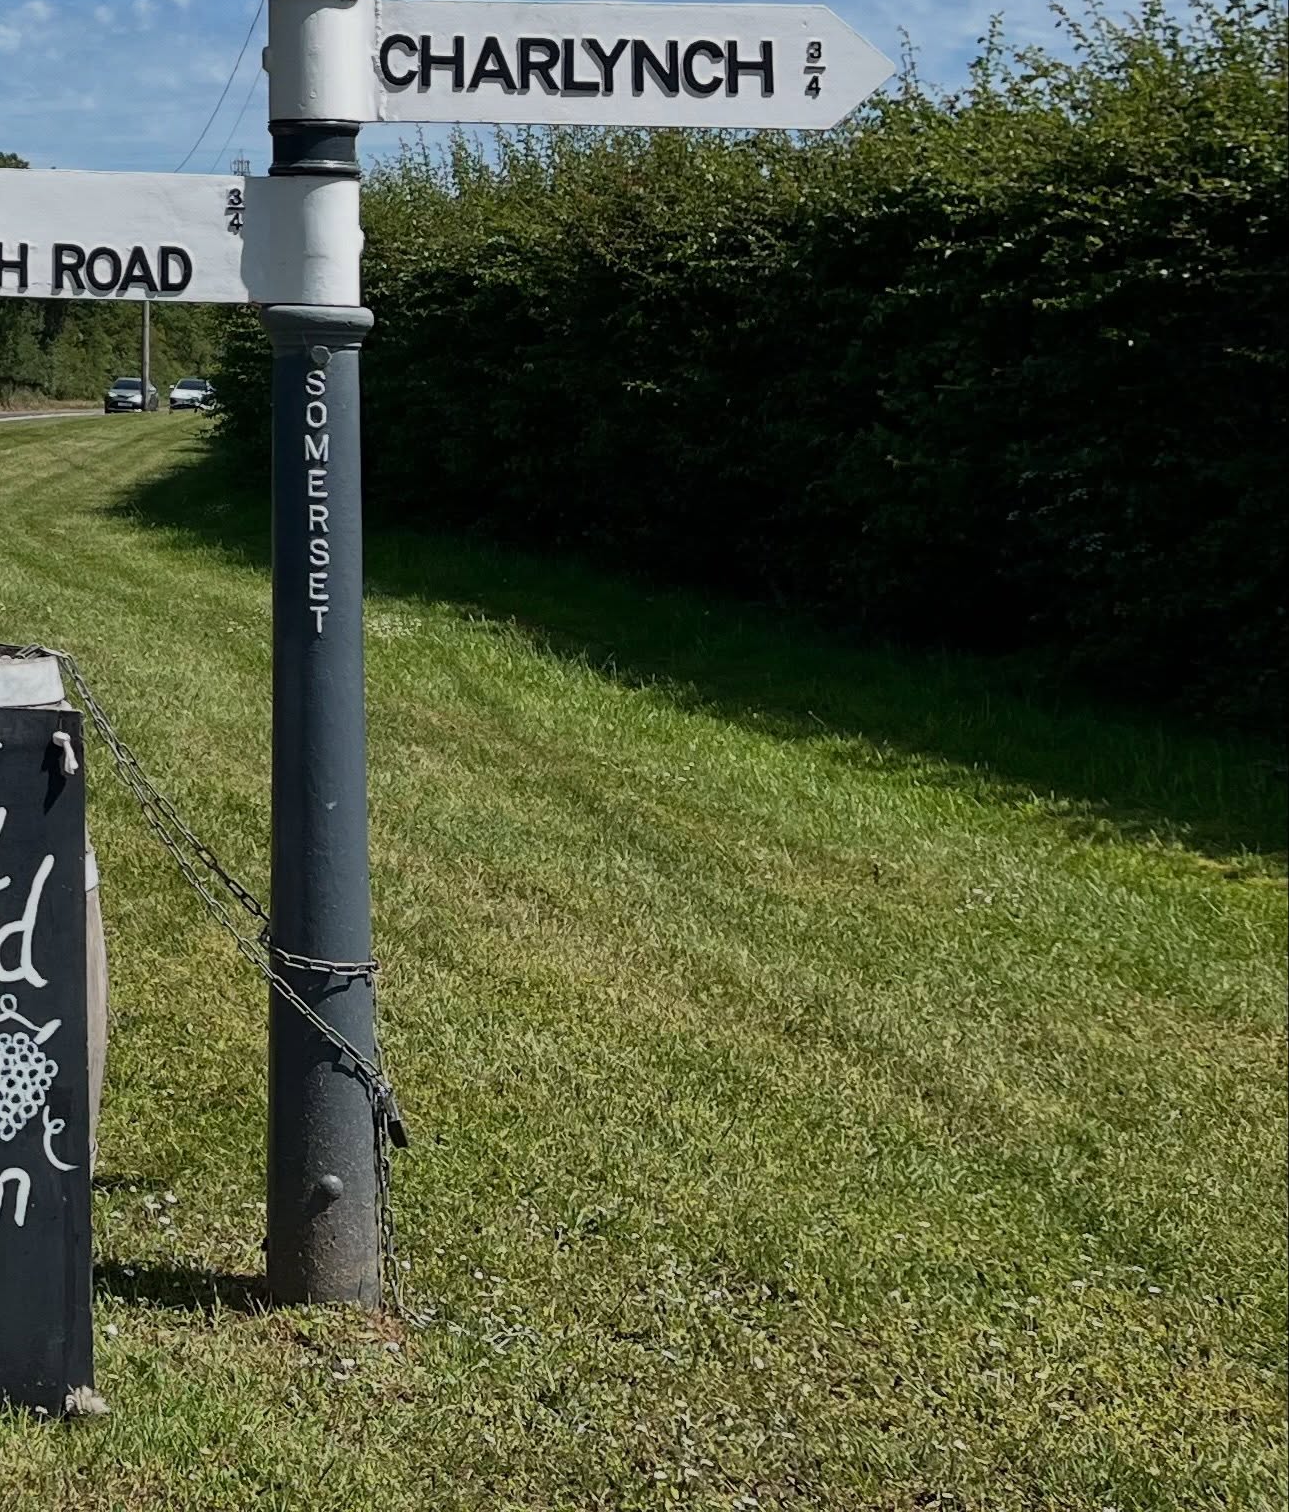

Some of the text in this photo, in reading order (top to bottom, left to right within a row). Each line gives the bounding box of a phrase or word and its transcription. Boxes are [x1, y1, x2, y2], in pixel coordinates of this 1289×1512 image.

[379, 34, 774, 97] CHARLYNCH
[51, 243, 192, 296] ROAD
[304, 370, 330, 634] SOMERSET
